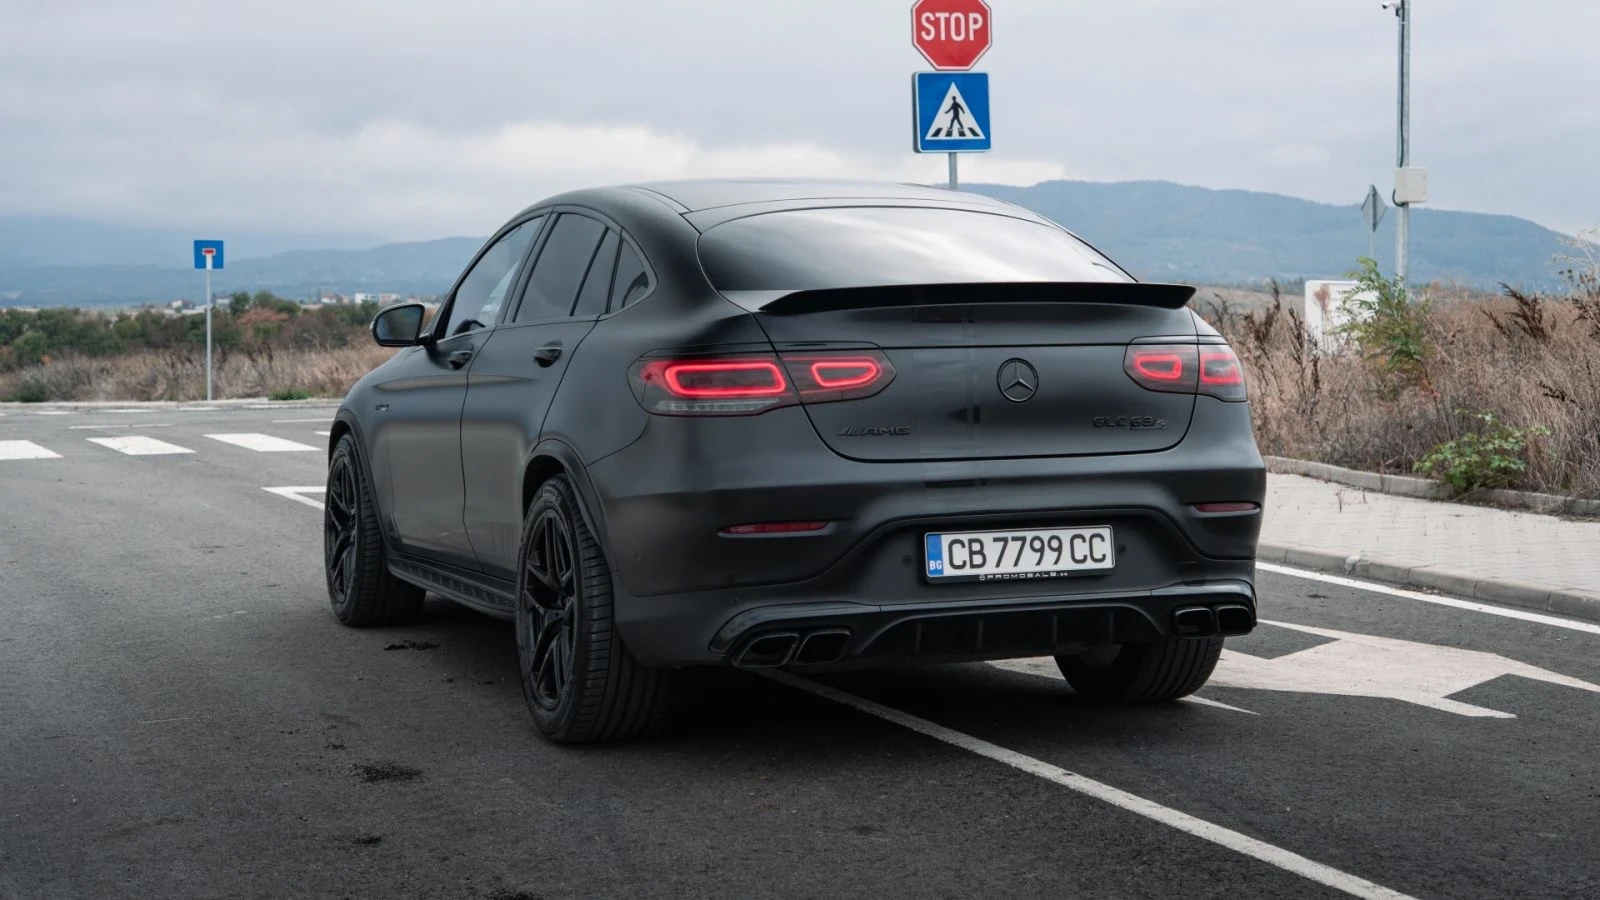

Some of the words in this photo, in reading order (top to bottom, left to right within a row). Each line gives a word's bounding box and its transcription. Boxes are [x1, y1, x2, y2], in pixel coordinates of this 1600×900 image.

[921, 12, 983, 41] STOP
[1092, 415, 1129, 428] GLC
[947, 537, 987, 570] CB
[992, 535, 1063, 568] 7799
[1069, 532, 1107, 565] CC
[929, 560, 942, 570] BG
